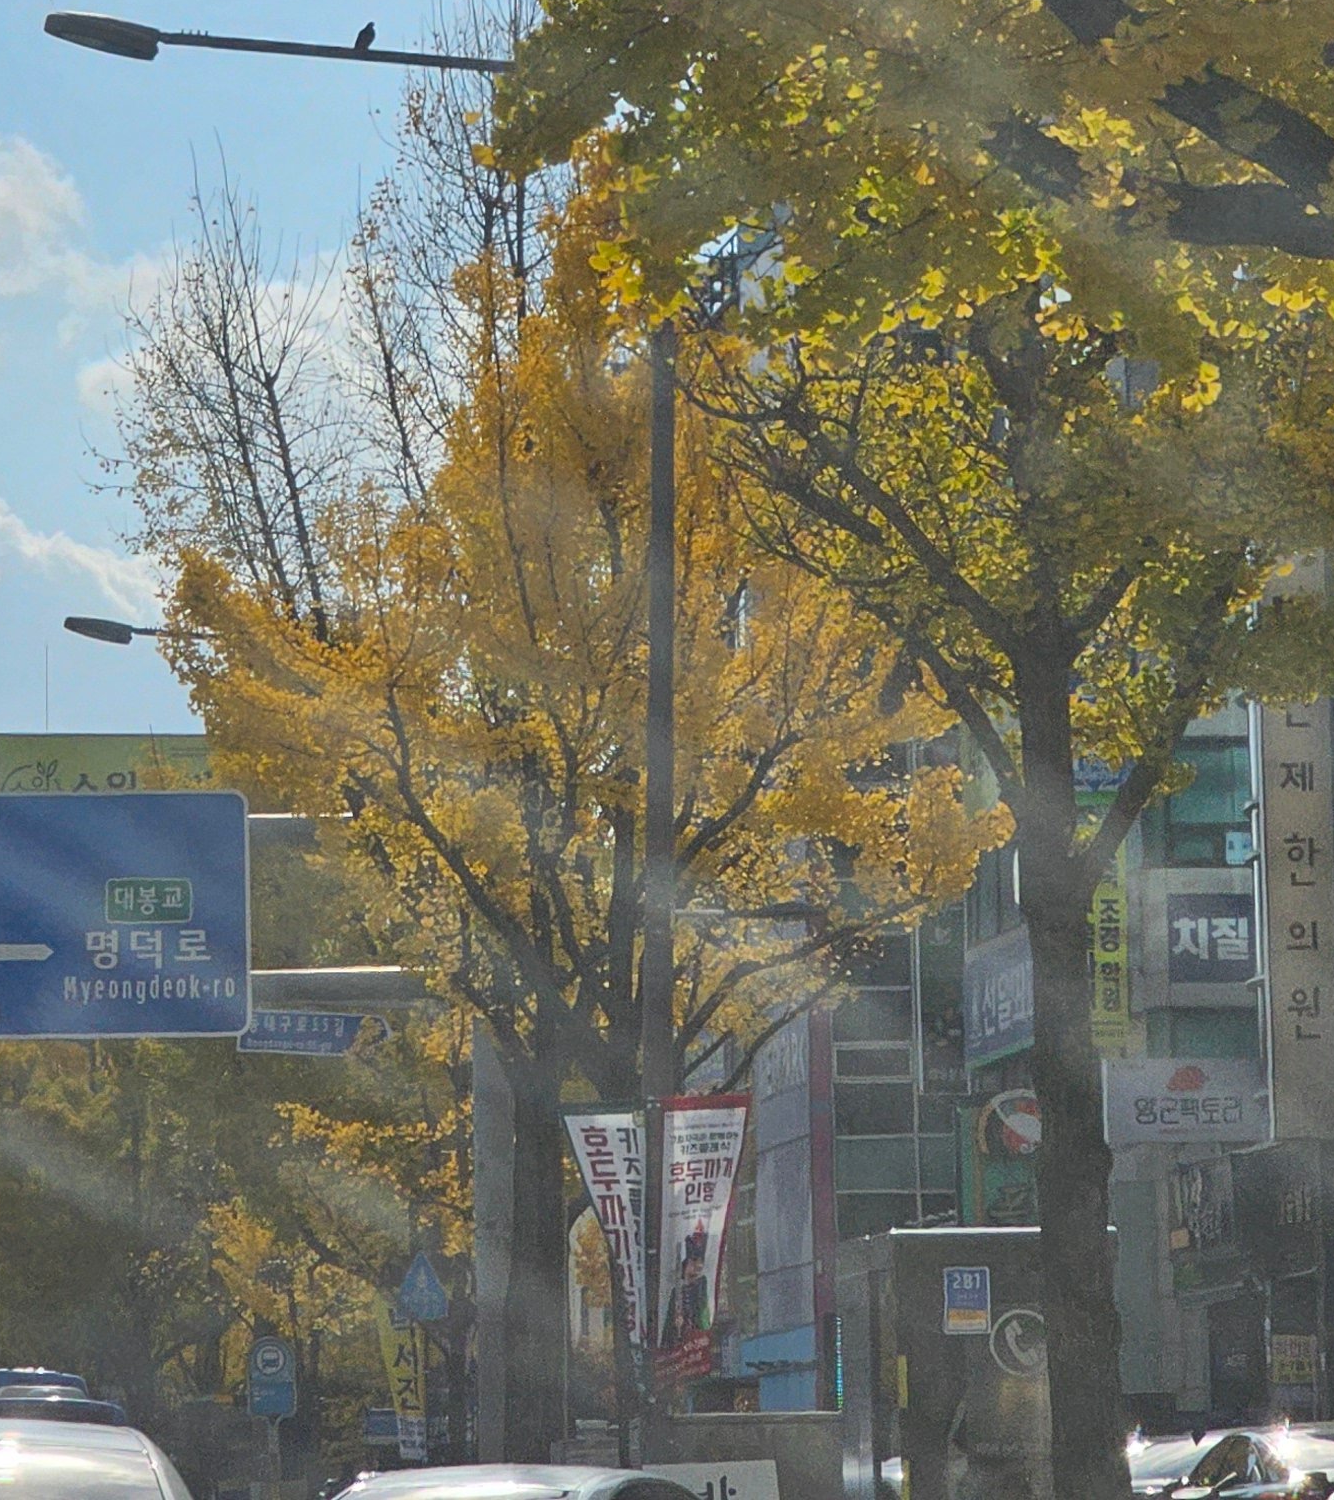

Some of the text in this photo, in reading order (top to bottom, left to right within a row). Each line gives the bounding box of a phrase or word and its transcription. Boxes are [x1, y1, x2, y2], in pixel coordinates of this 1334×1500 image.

[114, 884, 185, 916] 대봉교
[85, 929, 212, 970] 명덕로
[1173, 916, 1249, 962] 치질
[63, 975, 236, 1003] Myeongdeok-ro
[668, 1157, 734, 1184] 호두까기
[685, 1181, 717, 1206] 인형
